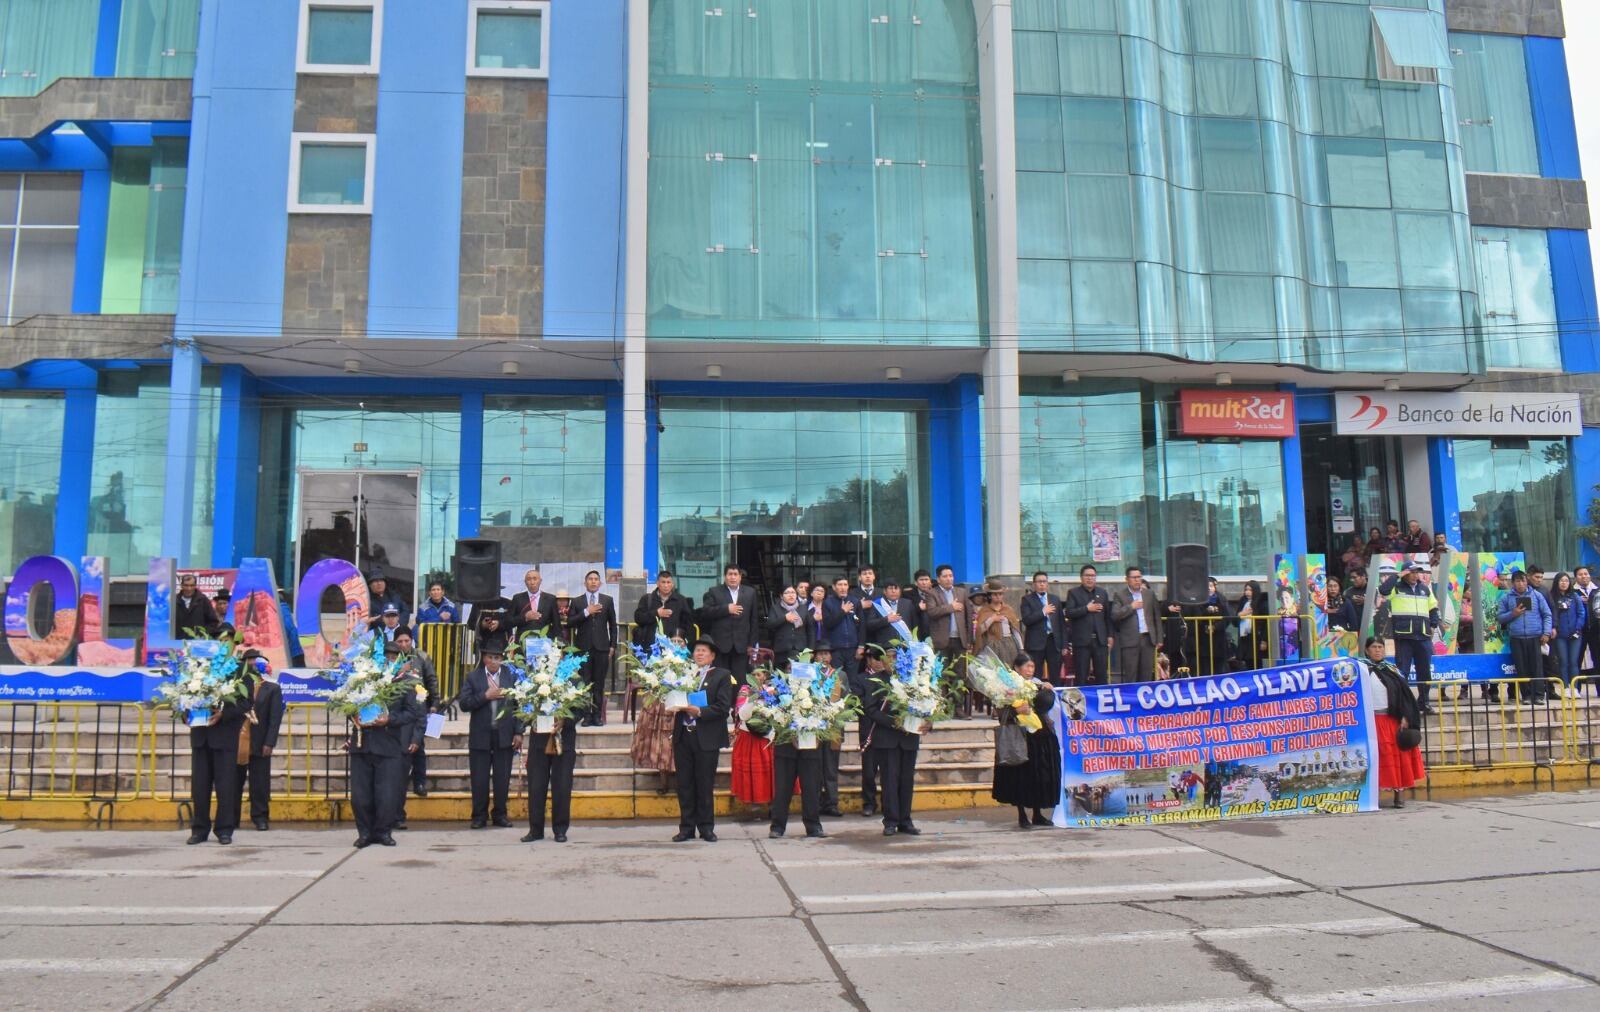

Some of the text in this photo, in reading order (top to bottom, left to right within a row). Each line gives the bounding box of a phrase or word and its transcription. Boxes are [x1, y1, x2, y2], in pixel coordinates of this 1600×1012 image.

[1398, 404, 1572, 423] Banco de la Nación
[1096, 667, 1327, 713] EL COLLAO- ILAVE
[1126, 717, 1134, 733] Y
[1137, 706, 1210, 732] REPARACIÓN
[1214, 709, 1221, 723] A
[1225, 705, 1247, 722] LOS
[1250, 697, 1317, 719] FAMILIARES
[1319, 693, 1333, 708] DE
[1336, 691, 1358, 707] LOS
[1070, 710, 1358, 754] 6 SOLDADOS MUERTOS POR RESPONSABILIDAD DEL
[1203, 747, 1210, 763] Y
[1212, 741, 1268, 762] CRIMINAL
[1271, 739, 1285, 754] DE
[1287, 729, 1347, 753] BOLUARTE!
[1225, 799, 1265, 816] JAMÁS
[1268, 794, 1299, 811] SERÁ
